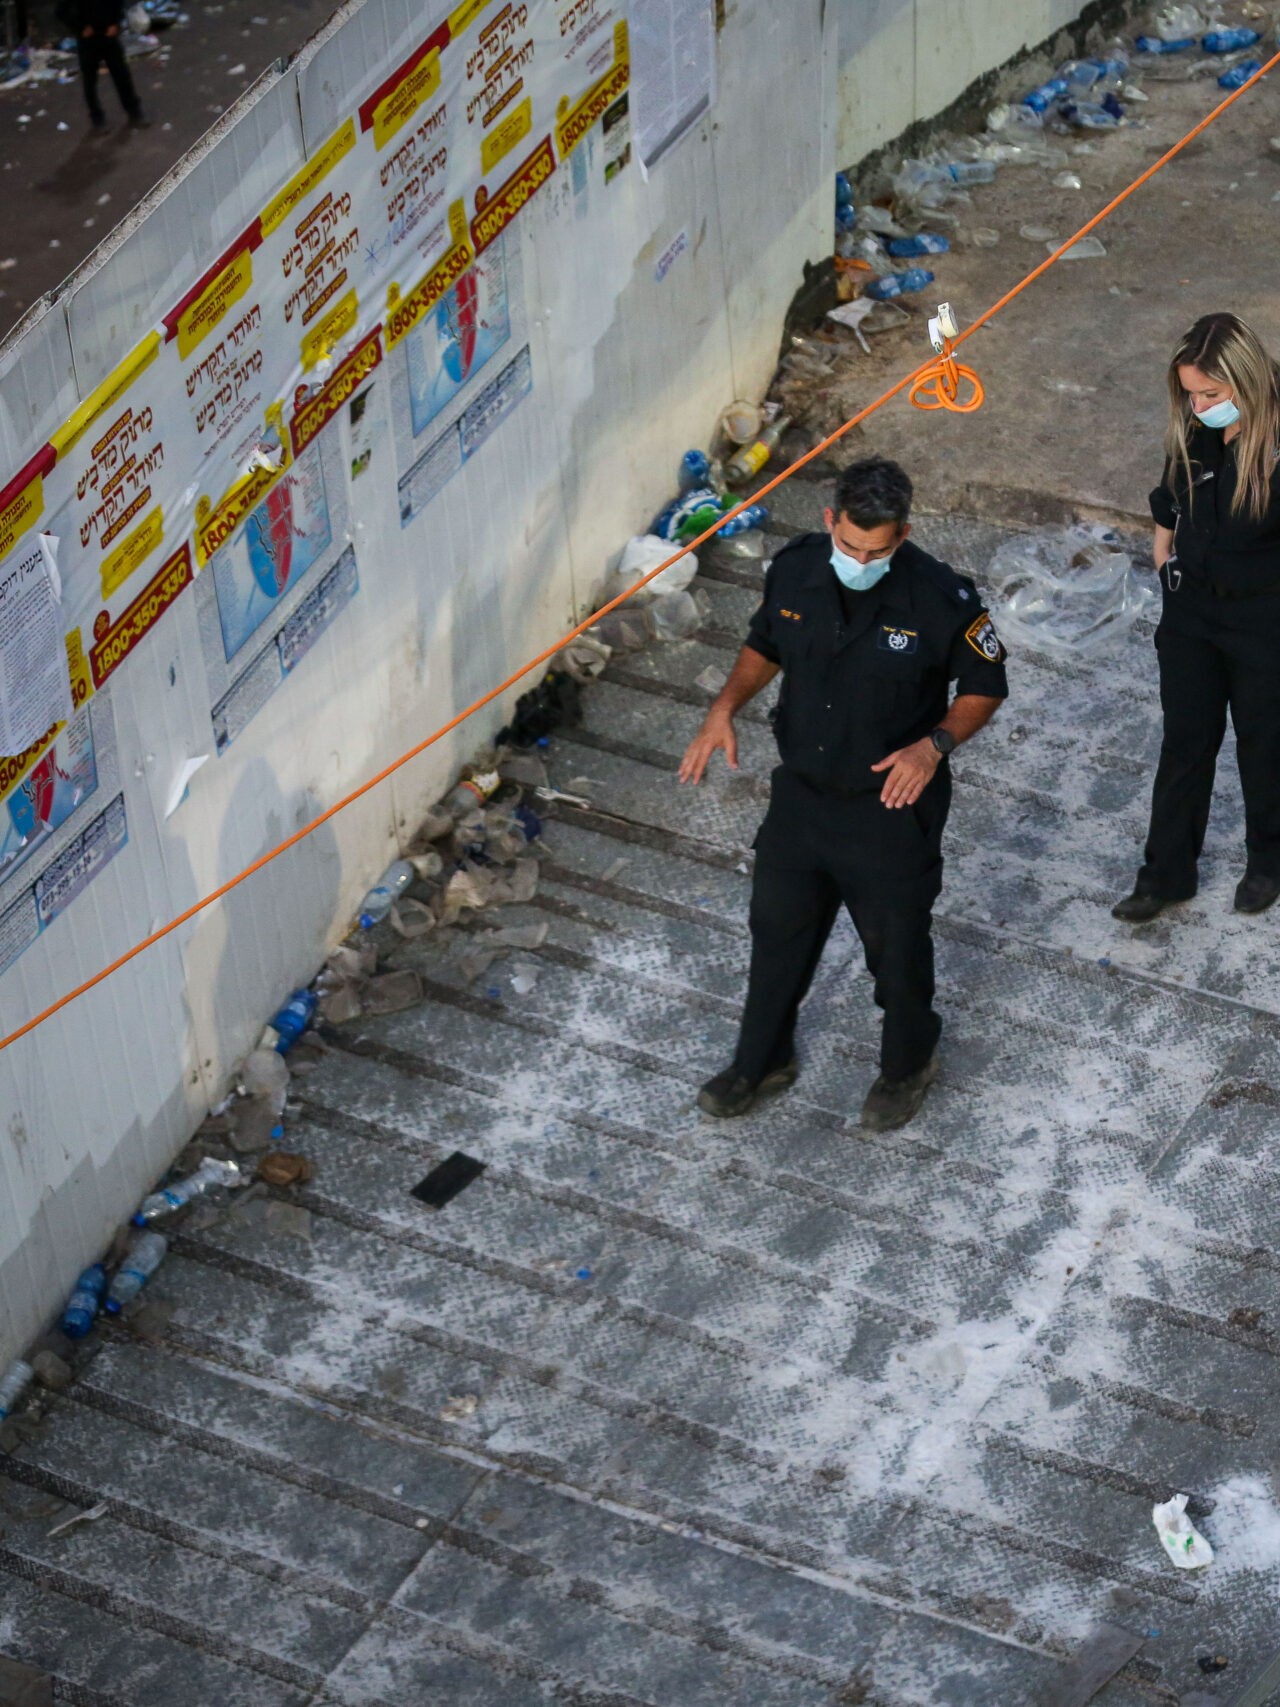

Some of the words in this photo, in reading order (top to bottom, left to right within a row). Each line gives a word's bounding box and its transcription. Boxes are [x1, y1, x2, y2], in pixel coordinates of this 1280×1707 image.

[389, 244, 470, 343] 1800-350-330
[297, 342, 377, 448] 1800-350-330
[95, 561, 187, 679] 1800-350-330
